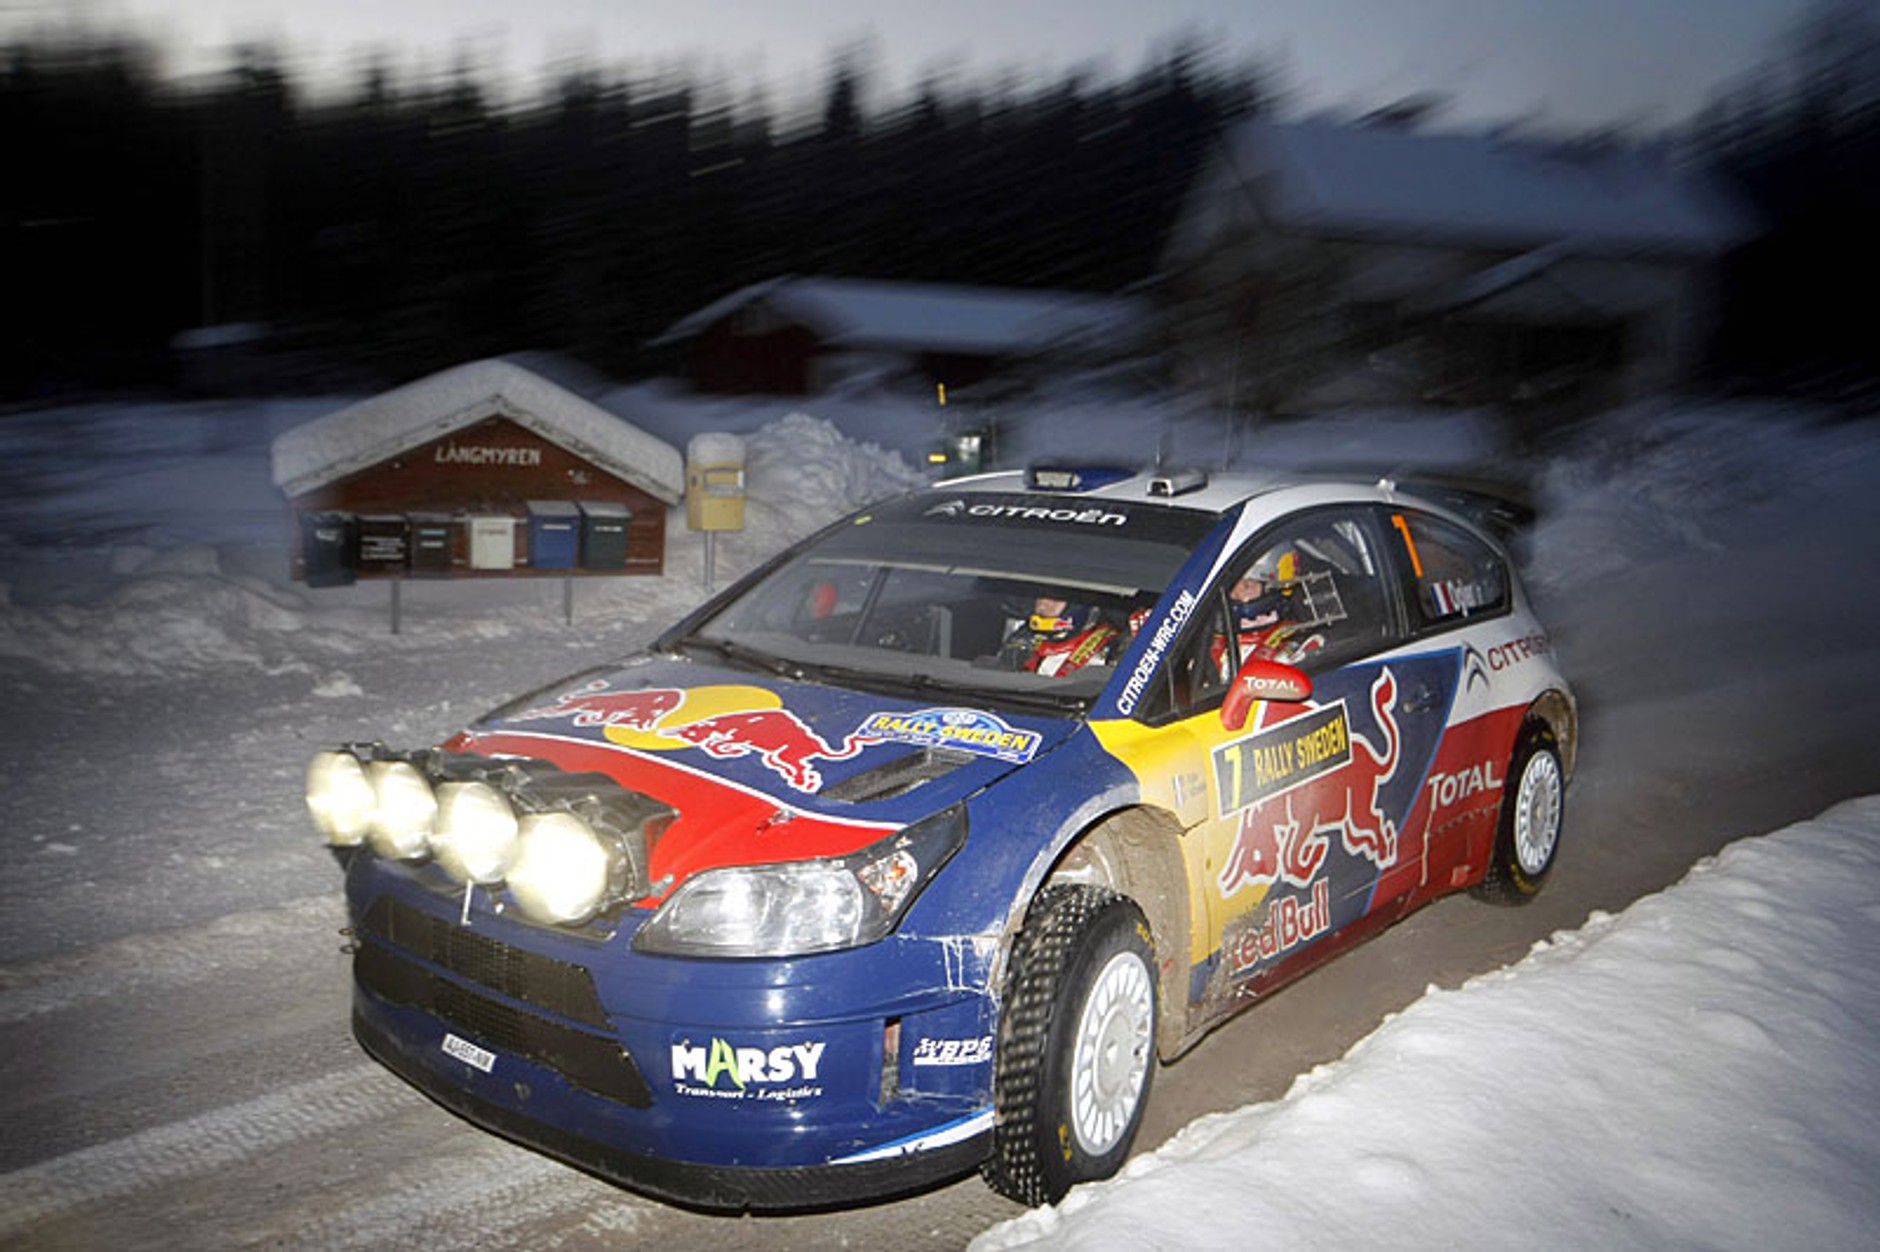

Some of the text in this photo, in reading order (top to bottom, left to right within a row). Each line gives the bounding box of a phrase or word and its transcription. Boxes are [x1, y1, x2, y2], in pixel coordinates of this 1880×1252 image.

[1116, 589, 1195, 716] CITROEN-WRC.COM
[872, 716, 937, 734] RALLY
[940, 724, 1031, 751] SWEDEN
[1252, 741, 1294, 787] RALLY
[1297, 714, 1346, 769] SWEDEN
[1427, 760, 1503, 813] TOTAL
[1280, 876, 1330, 950] Bull
[671, 1037, 826, 1088] MARSY
